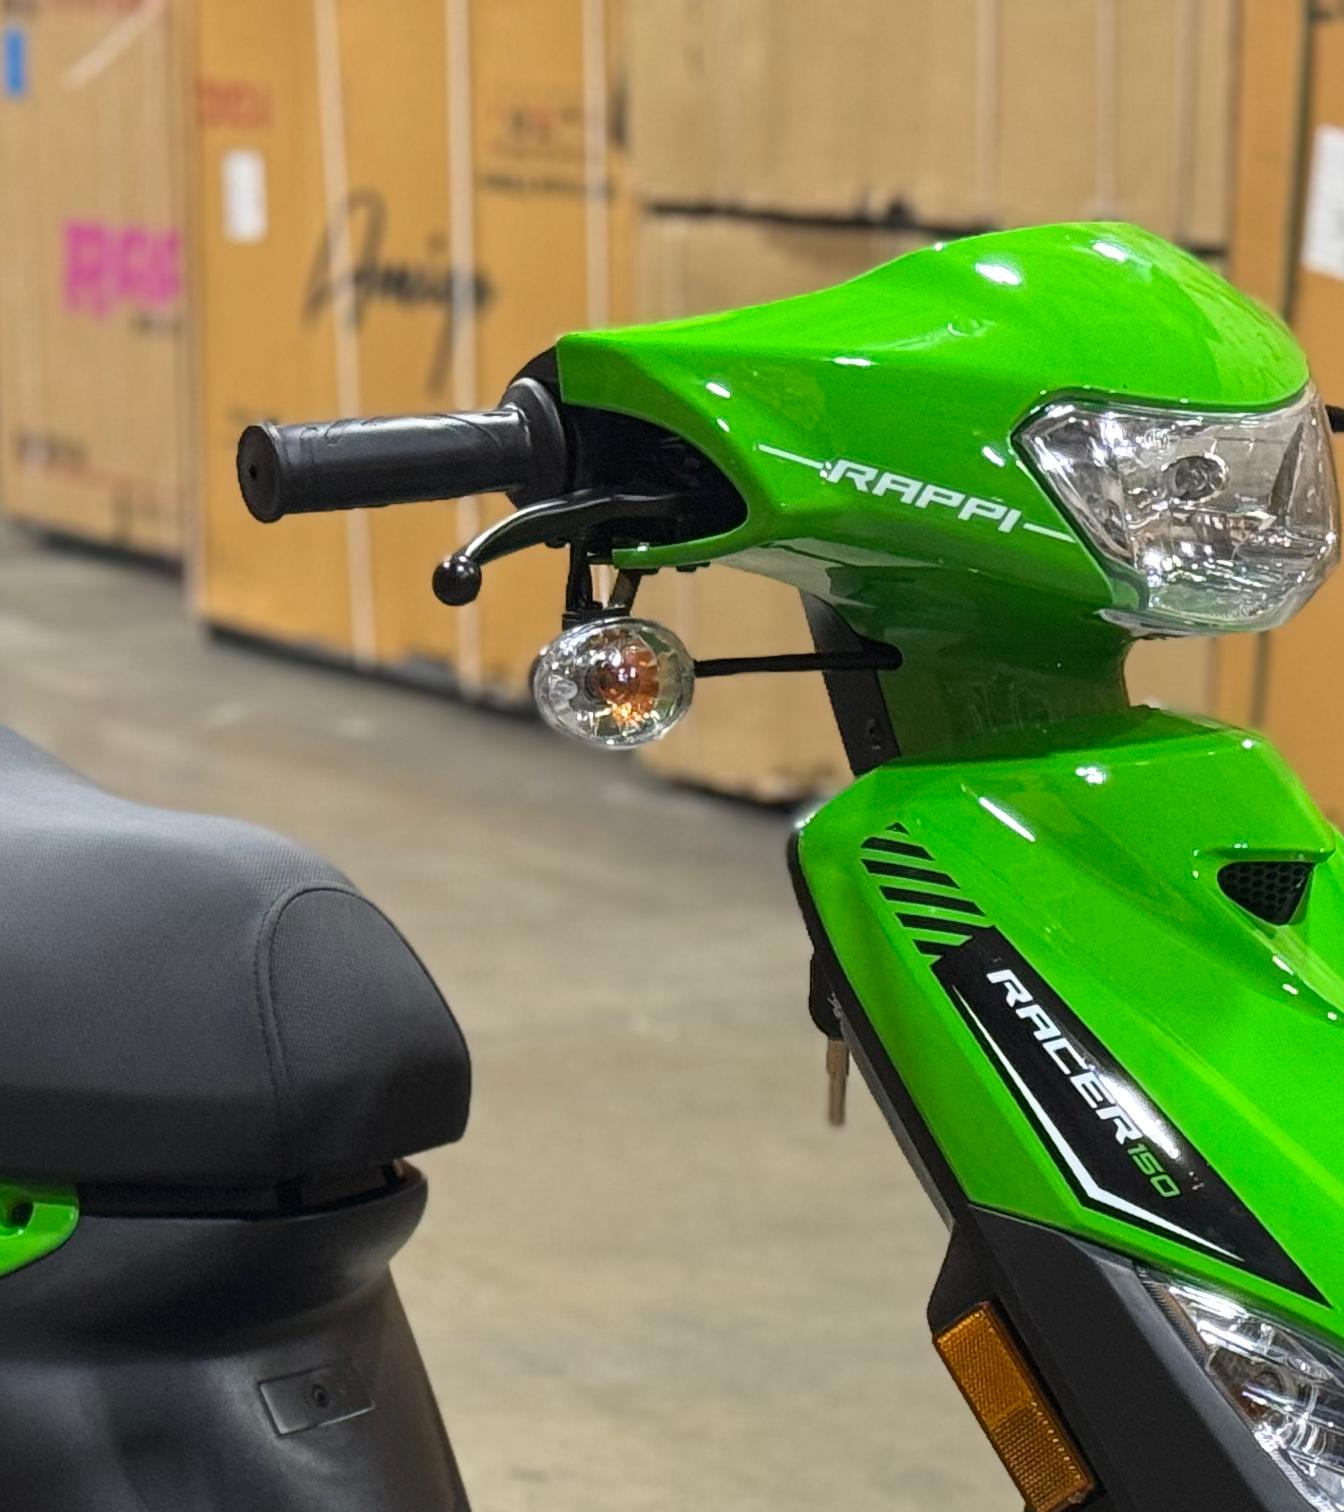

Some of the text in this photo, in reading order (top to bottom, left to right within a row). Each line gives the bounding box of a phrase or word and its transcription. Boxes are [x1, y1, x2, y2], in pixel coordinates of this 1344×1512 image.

[826, 458, 1022, 533] RAPPI
[986, 969, 1181, 1199] RACER 150
